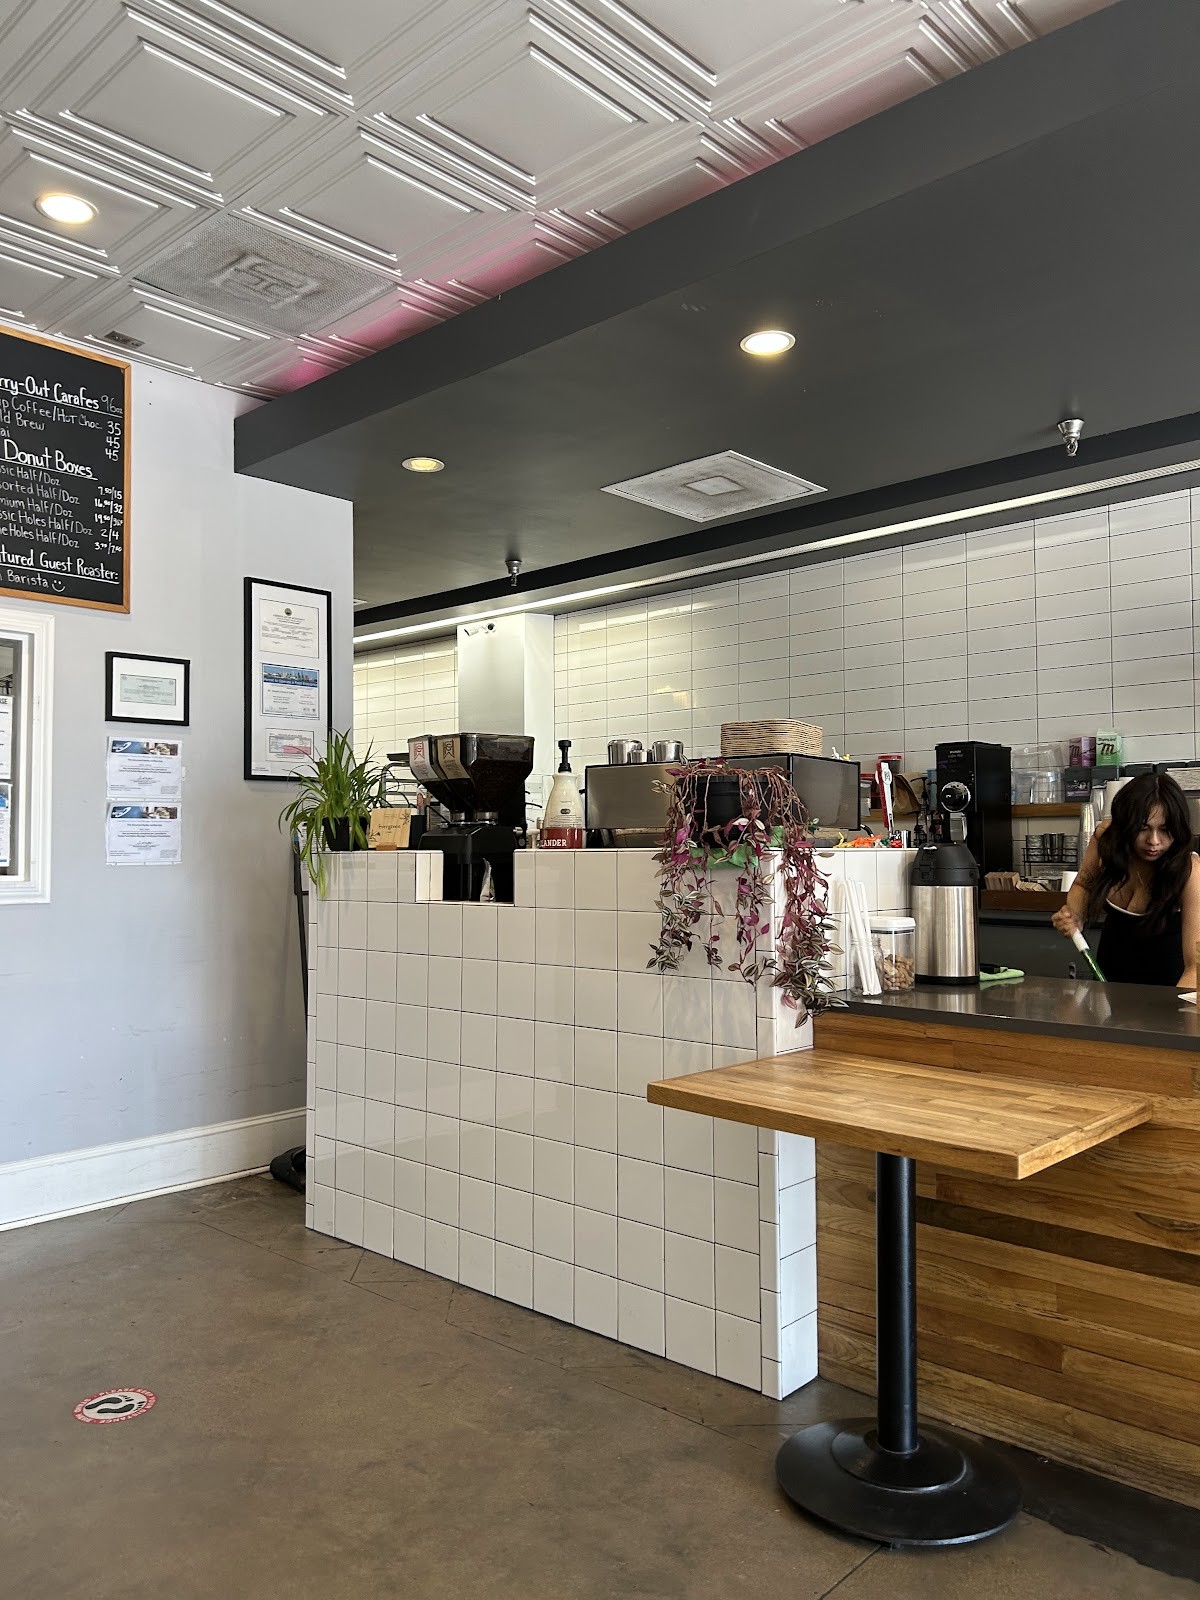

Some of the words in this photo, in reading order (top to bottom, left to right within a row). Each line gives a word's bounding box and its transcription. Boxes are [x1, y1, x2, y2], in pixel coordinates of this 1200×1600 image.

[54, 383, 99, 410] Carafes
[15, 412, 45, 431] Brew
[106, 436, 120, 449] 45
[107, 421, 121, 436] 35
[4, 439, 52, 467] Donut
[55, 450, 93, 478] Boxes
[105, 448, 119, 461] 45
[16, 466, 60, 485] Half/Doz
[36, 484, 80, 504] Half/Doz
[27, 497, 73, 517] Half/Doz
[18, 510, 46, 527] Holes
[48, 516, 93, 536] Half/Doz
[9, 523, 34, 540] Holes
[36, 529, 80, 548] Half/Doz
[40, 552, 73, 572] Guest
[77, 558, 119, 580] Roaster:
[7, 569, 49, 588] Barista
